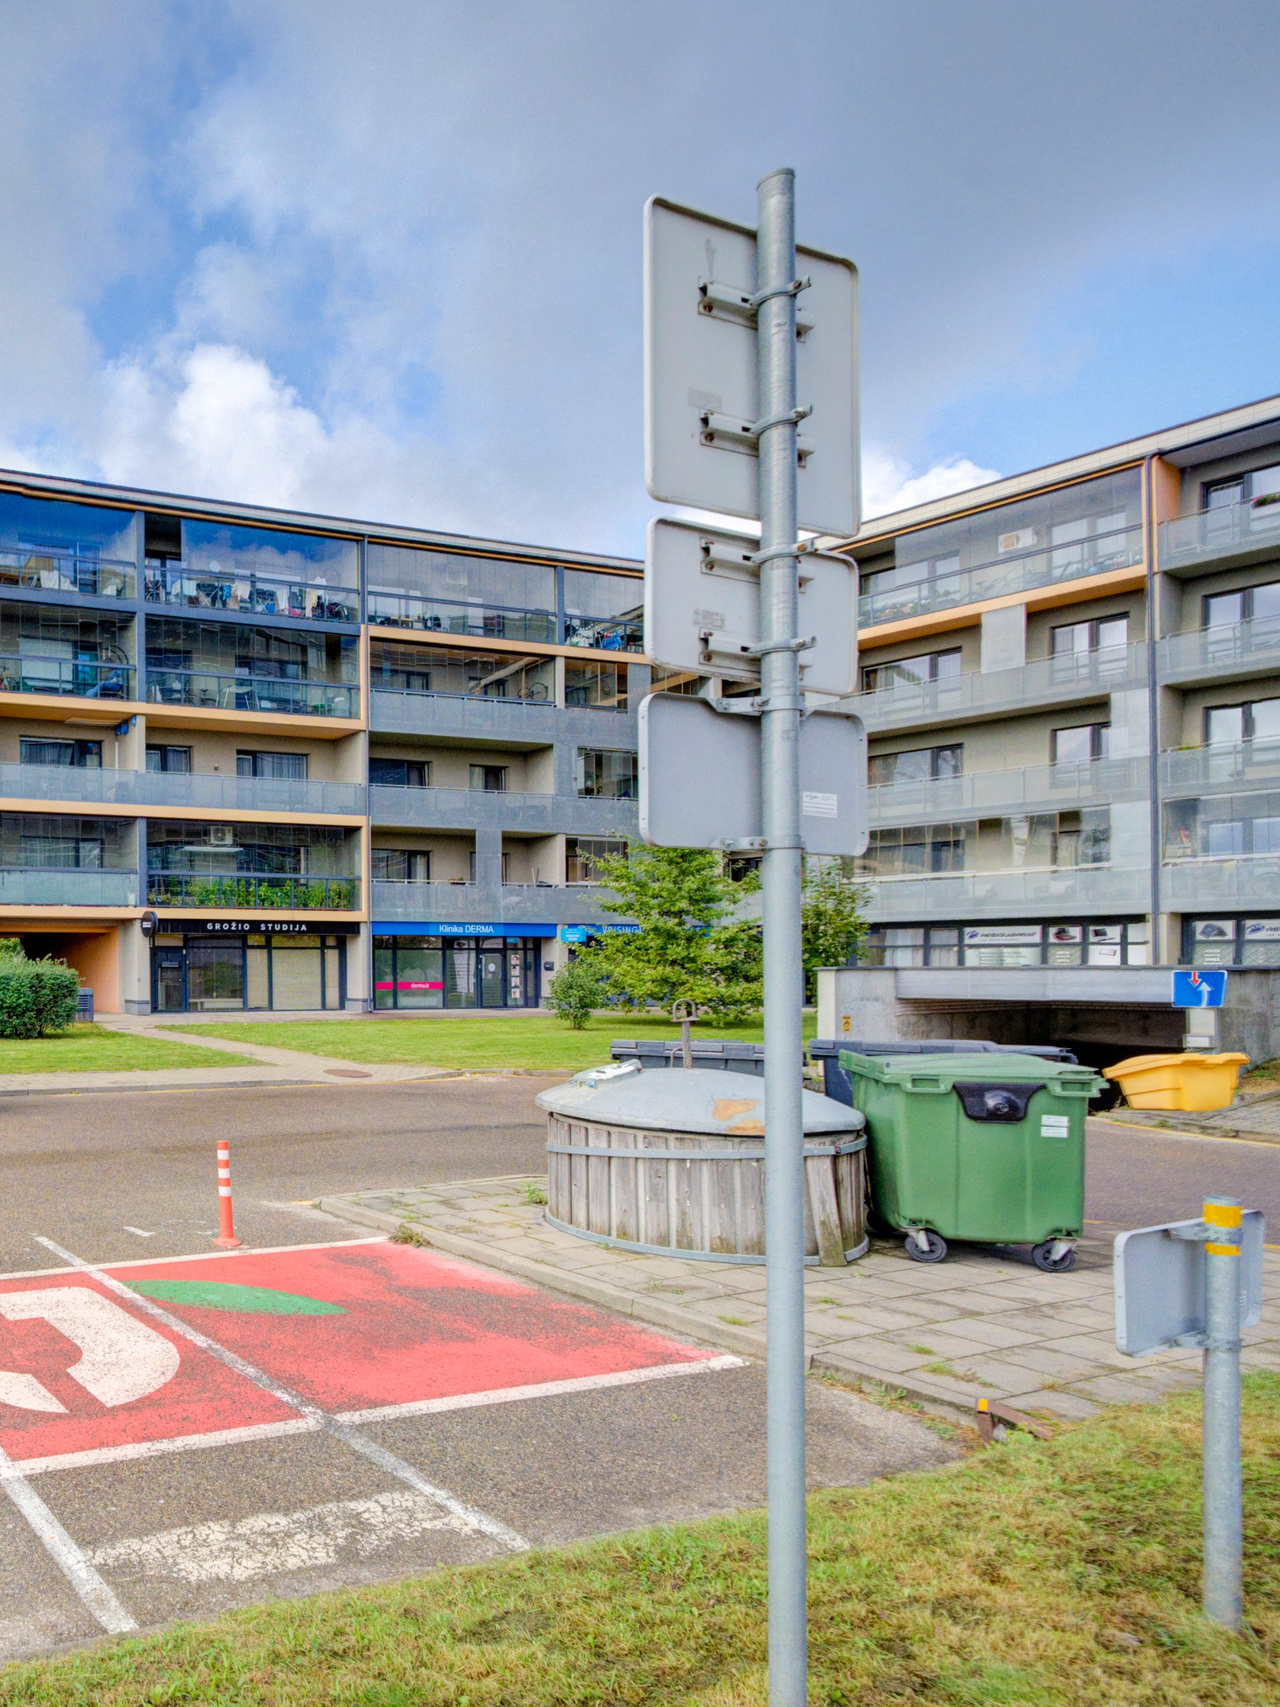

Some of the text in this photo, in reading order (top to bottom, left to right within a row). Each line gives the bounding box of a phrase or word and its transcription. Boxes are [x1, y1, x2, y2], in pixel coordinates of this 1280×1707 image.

[206, 921, 308, 931] GROŽIO STUDIJA
[439, 924, 494, 934] Klinika DERMA
